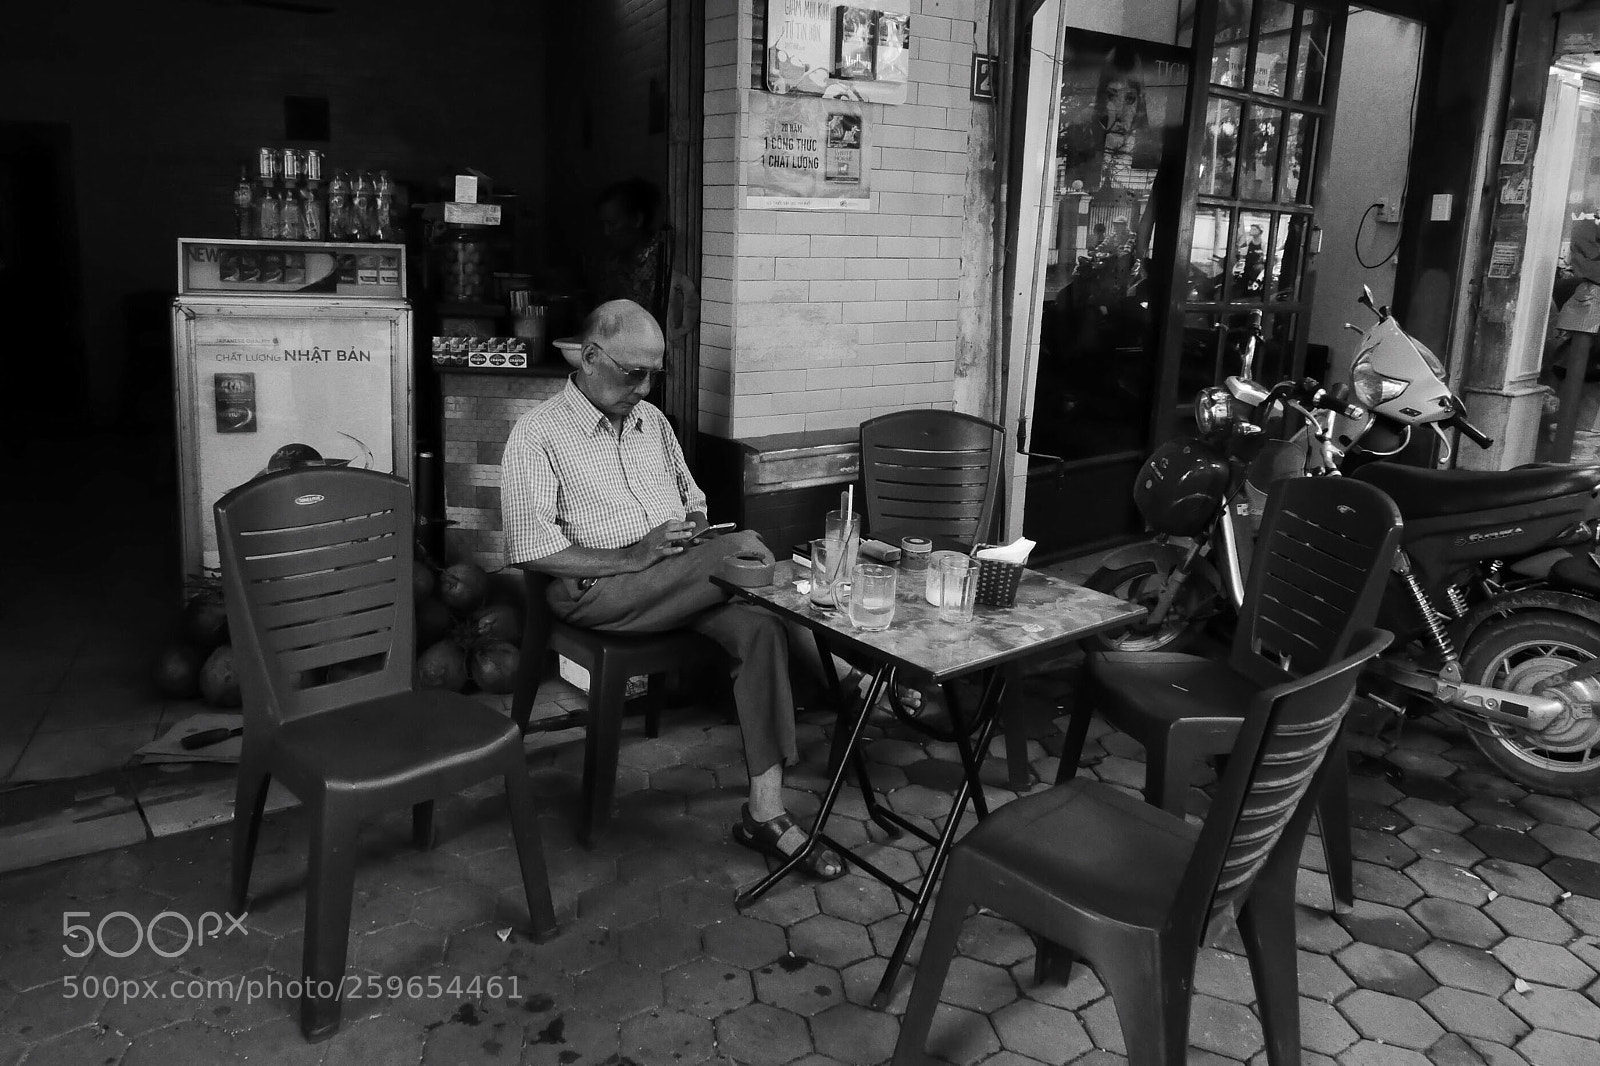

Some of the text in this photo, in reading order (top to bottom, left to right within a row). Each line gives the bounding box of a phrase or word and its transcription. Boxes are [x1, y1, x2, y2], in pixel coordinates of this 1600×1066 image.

[764, 136, 769, 150] 1
[771, 135, 794, 151] CÔNG
[761, 154, 766, 168] 1
[189, 246, 219, 263] NEW
[284, 346, 331, 364] NHẬT
[336, 346, 371, 362] BẢN
